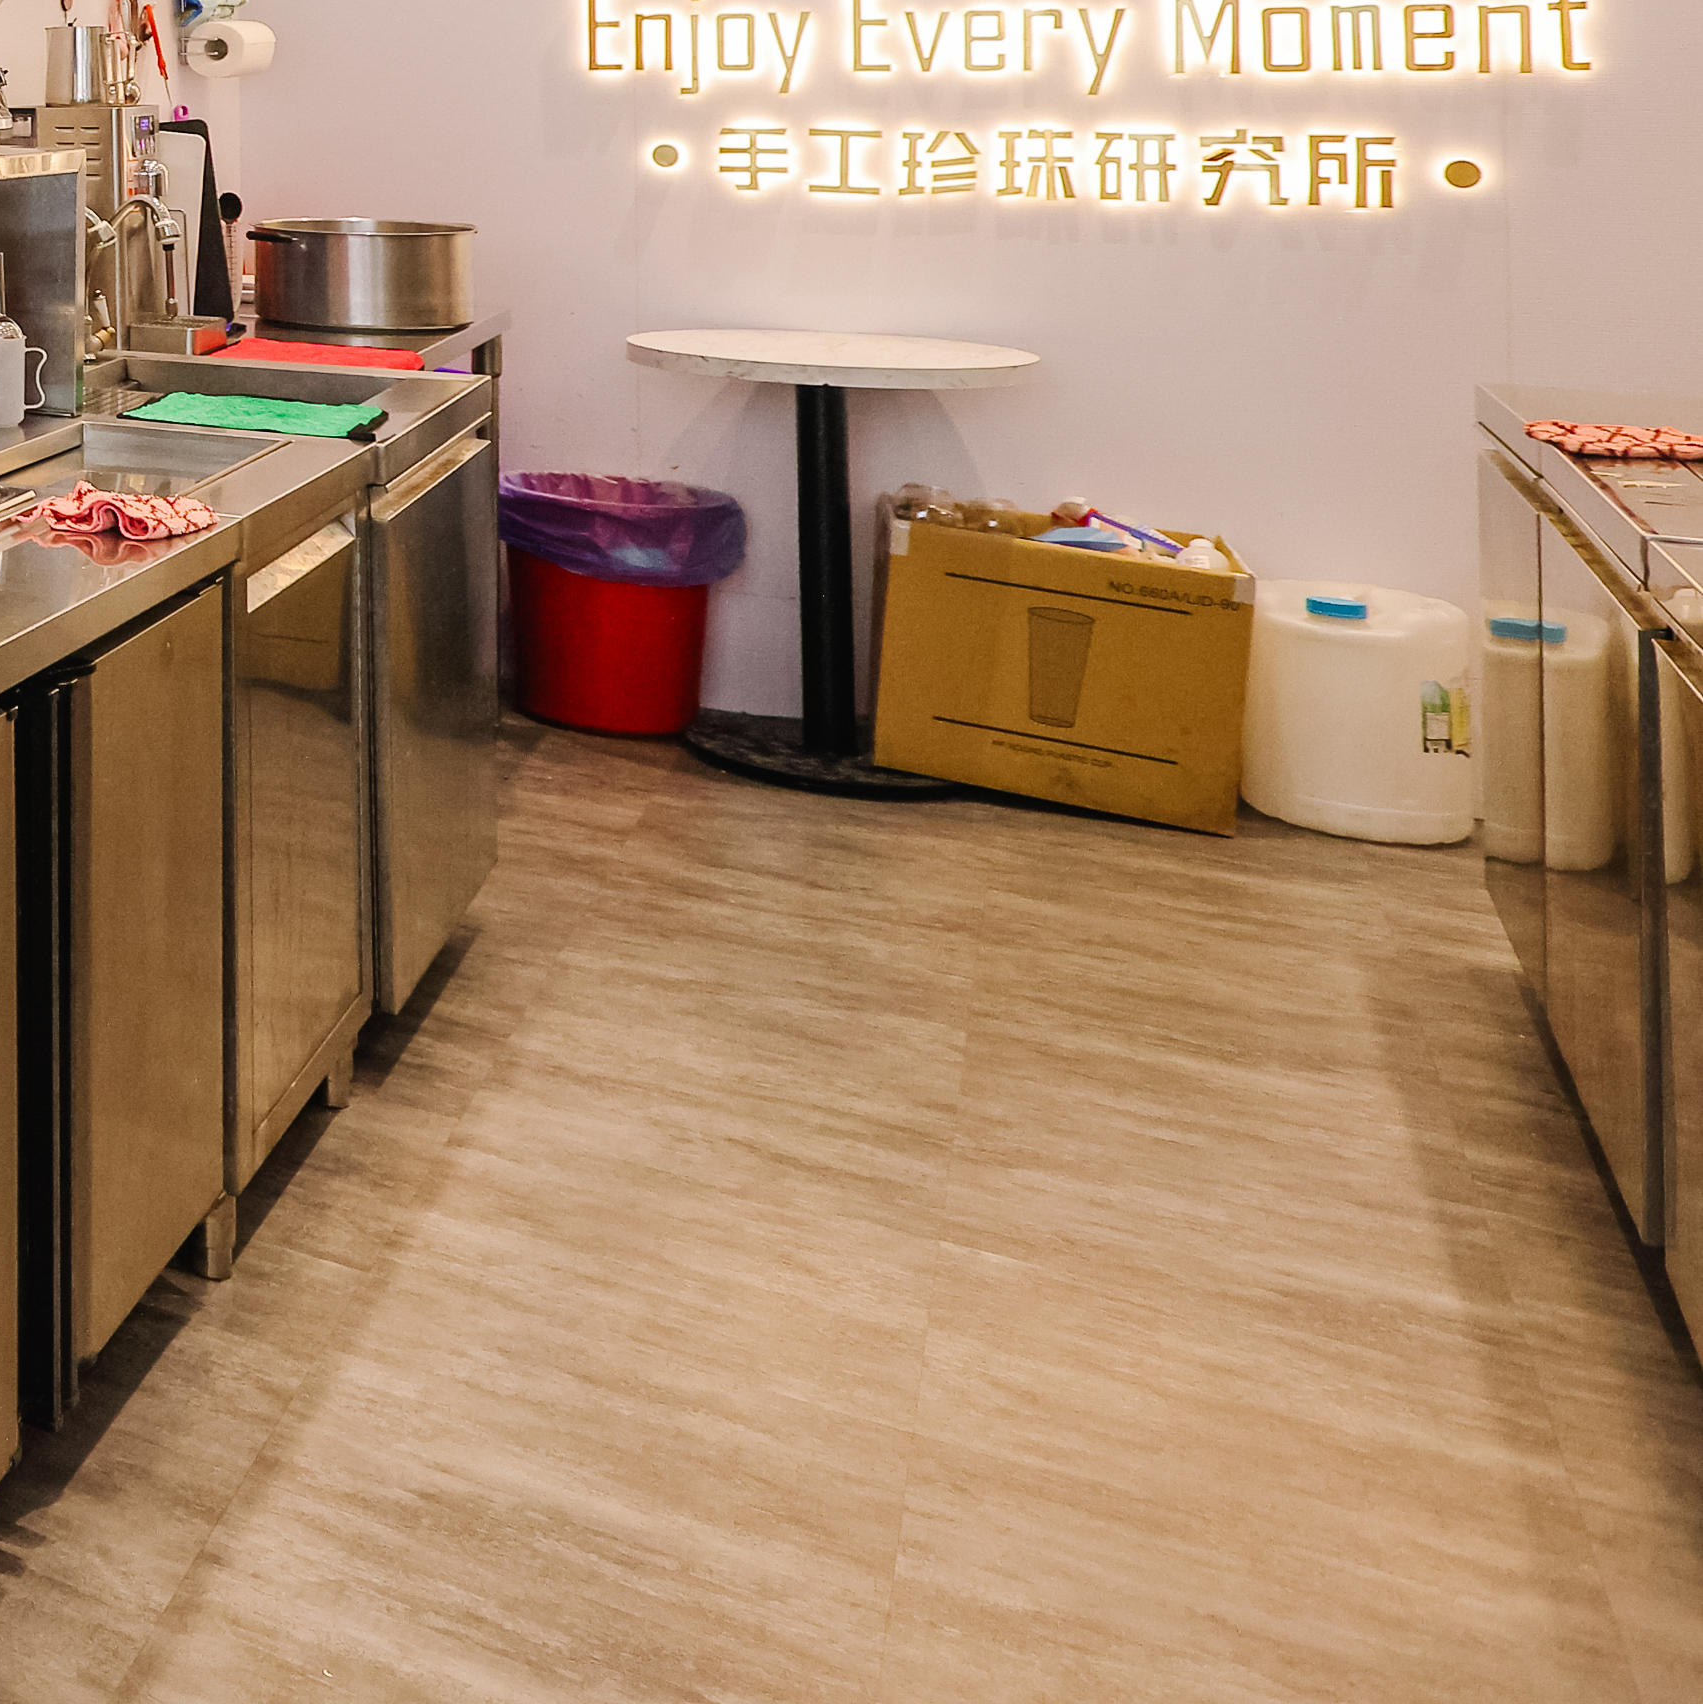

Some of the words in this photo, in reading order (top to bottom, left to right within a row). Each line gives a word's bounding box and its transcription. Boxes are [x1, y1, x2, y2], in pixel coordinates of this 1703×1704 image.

[717, 126, 1399, 210] 手工珍珠研究所
